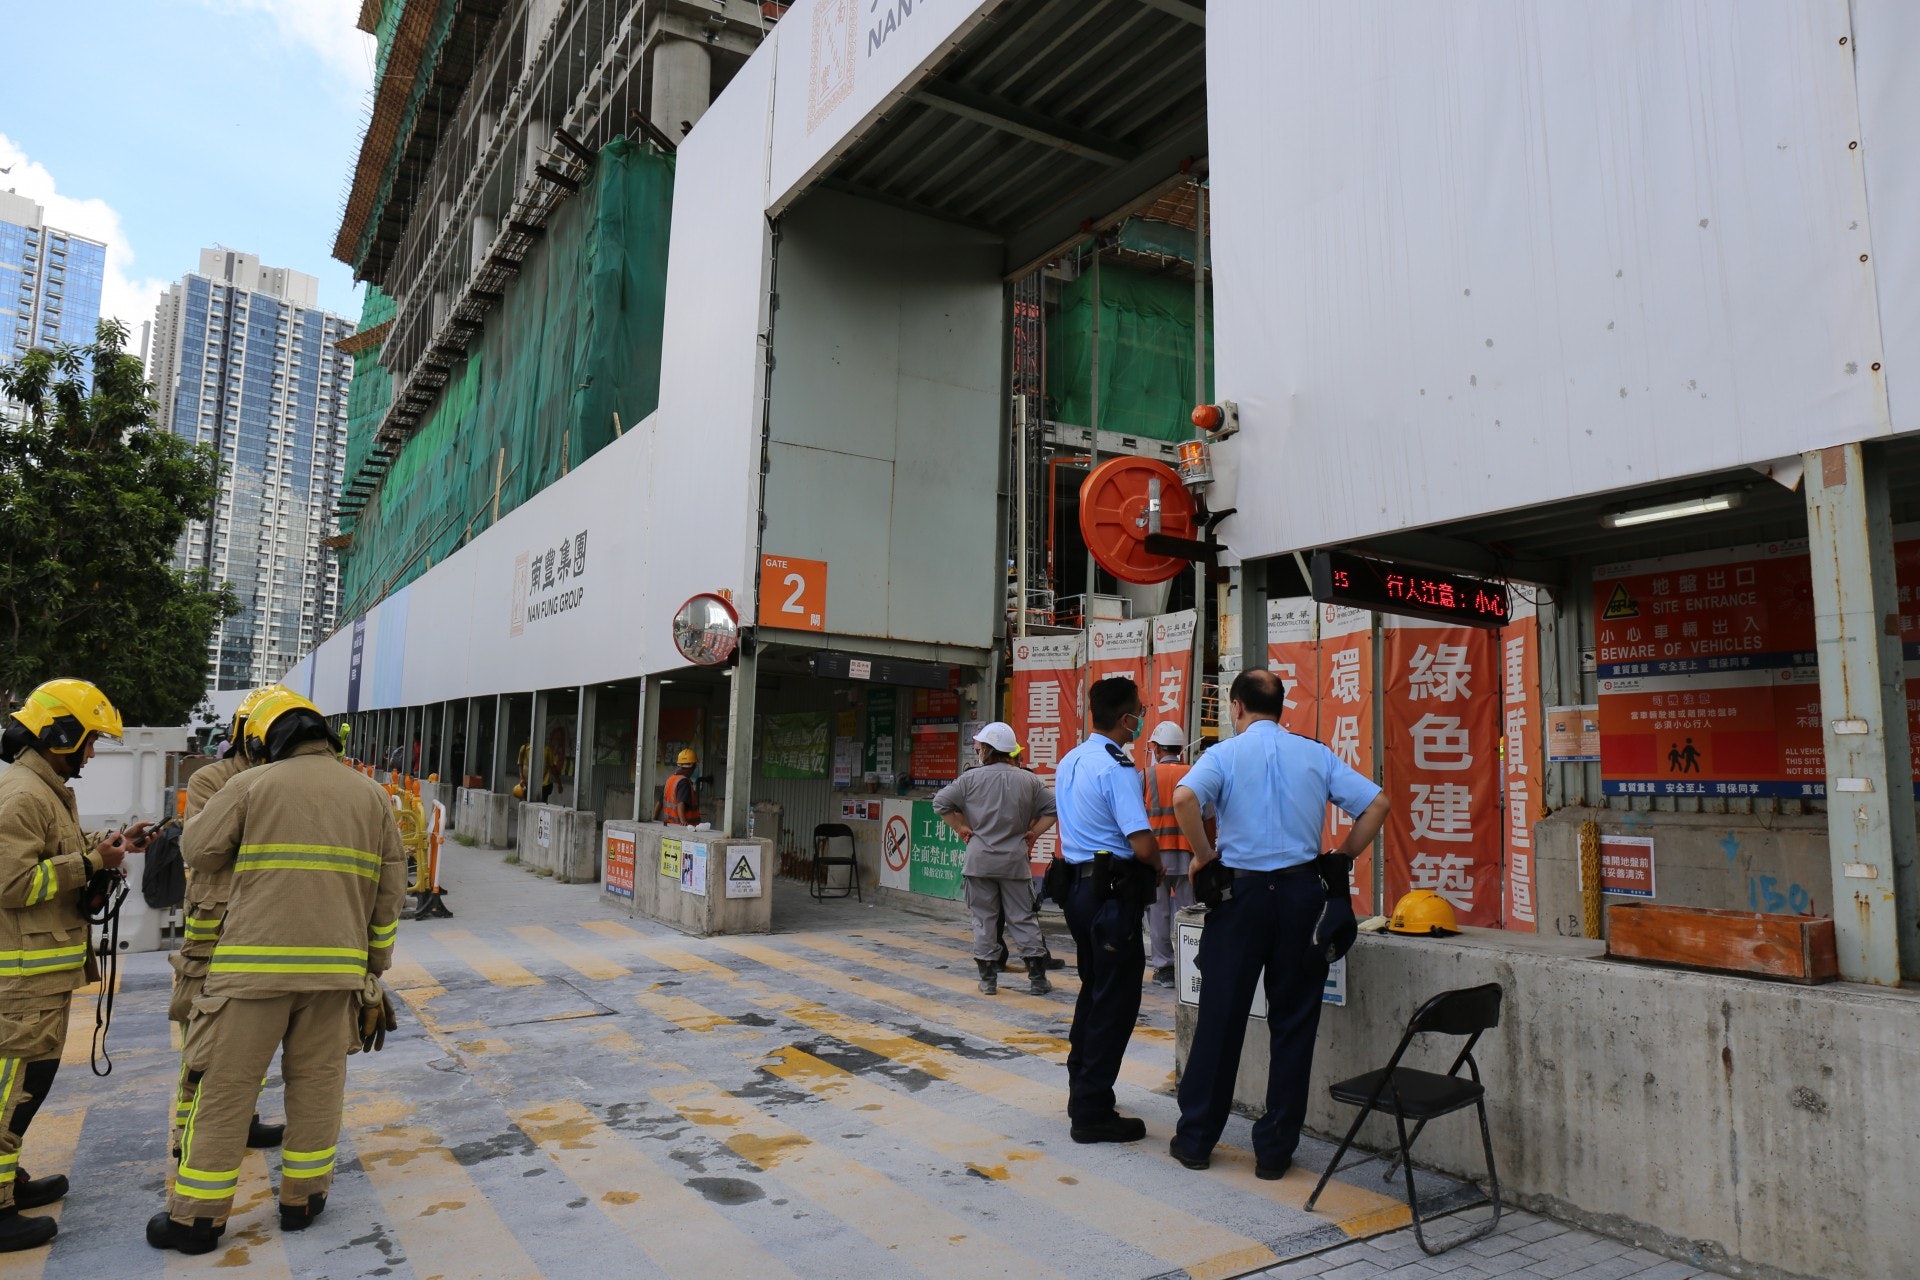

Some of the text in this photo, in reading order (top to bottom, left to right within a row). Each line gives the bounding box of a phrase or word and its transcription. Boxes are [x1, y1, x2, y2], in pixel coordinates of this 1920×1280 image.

[867, 0, 913, 58] NAN
[529, 529, 588, 597] 南豐集團
[765, 558, 788, 569] GATE
[781, 573, 806, 614] 2
[1651, 567, 1755, 595] 地盤出口
[527, 587, 584, 623] NAN FUNG GROUP
[1652, 591, 1757, 615] SITE ENTRANCE
[1600, 616, 1760, 644] 小心車輛出入
[1601, 644, 1656, 661] BEWARE
[1664, 642, 1682, 656] OF
[1691, 635, 1763, 654] VEHICLES
[1612, 663, 1649, 676] 重質重量
[1658, 661, 1698, 672] 安全至上
[1795, 703, 1821, 715] 一切
[1797, 716, 1822, 728] 不得
[1654, 719, 1712, 730] 必須小心行人
[1408, 643, 1474, 913] 綠色建築
[1505, 636, 1535, 923] 重質重量
[1618, 782, 1760, 794] 重質重量 安全至上 環保同享
[1183, 934, 1201, 947] Plea
